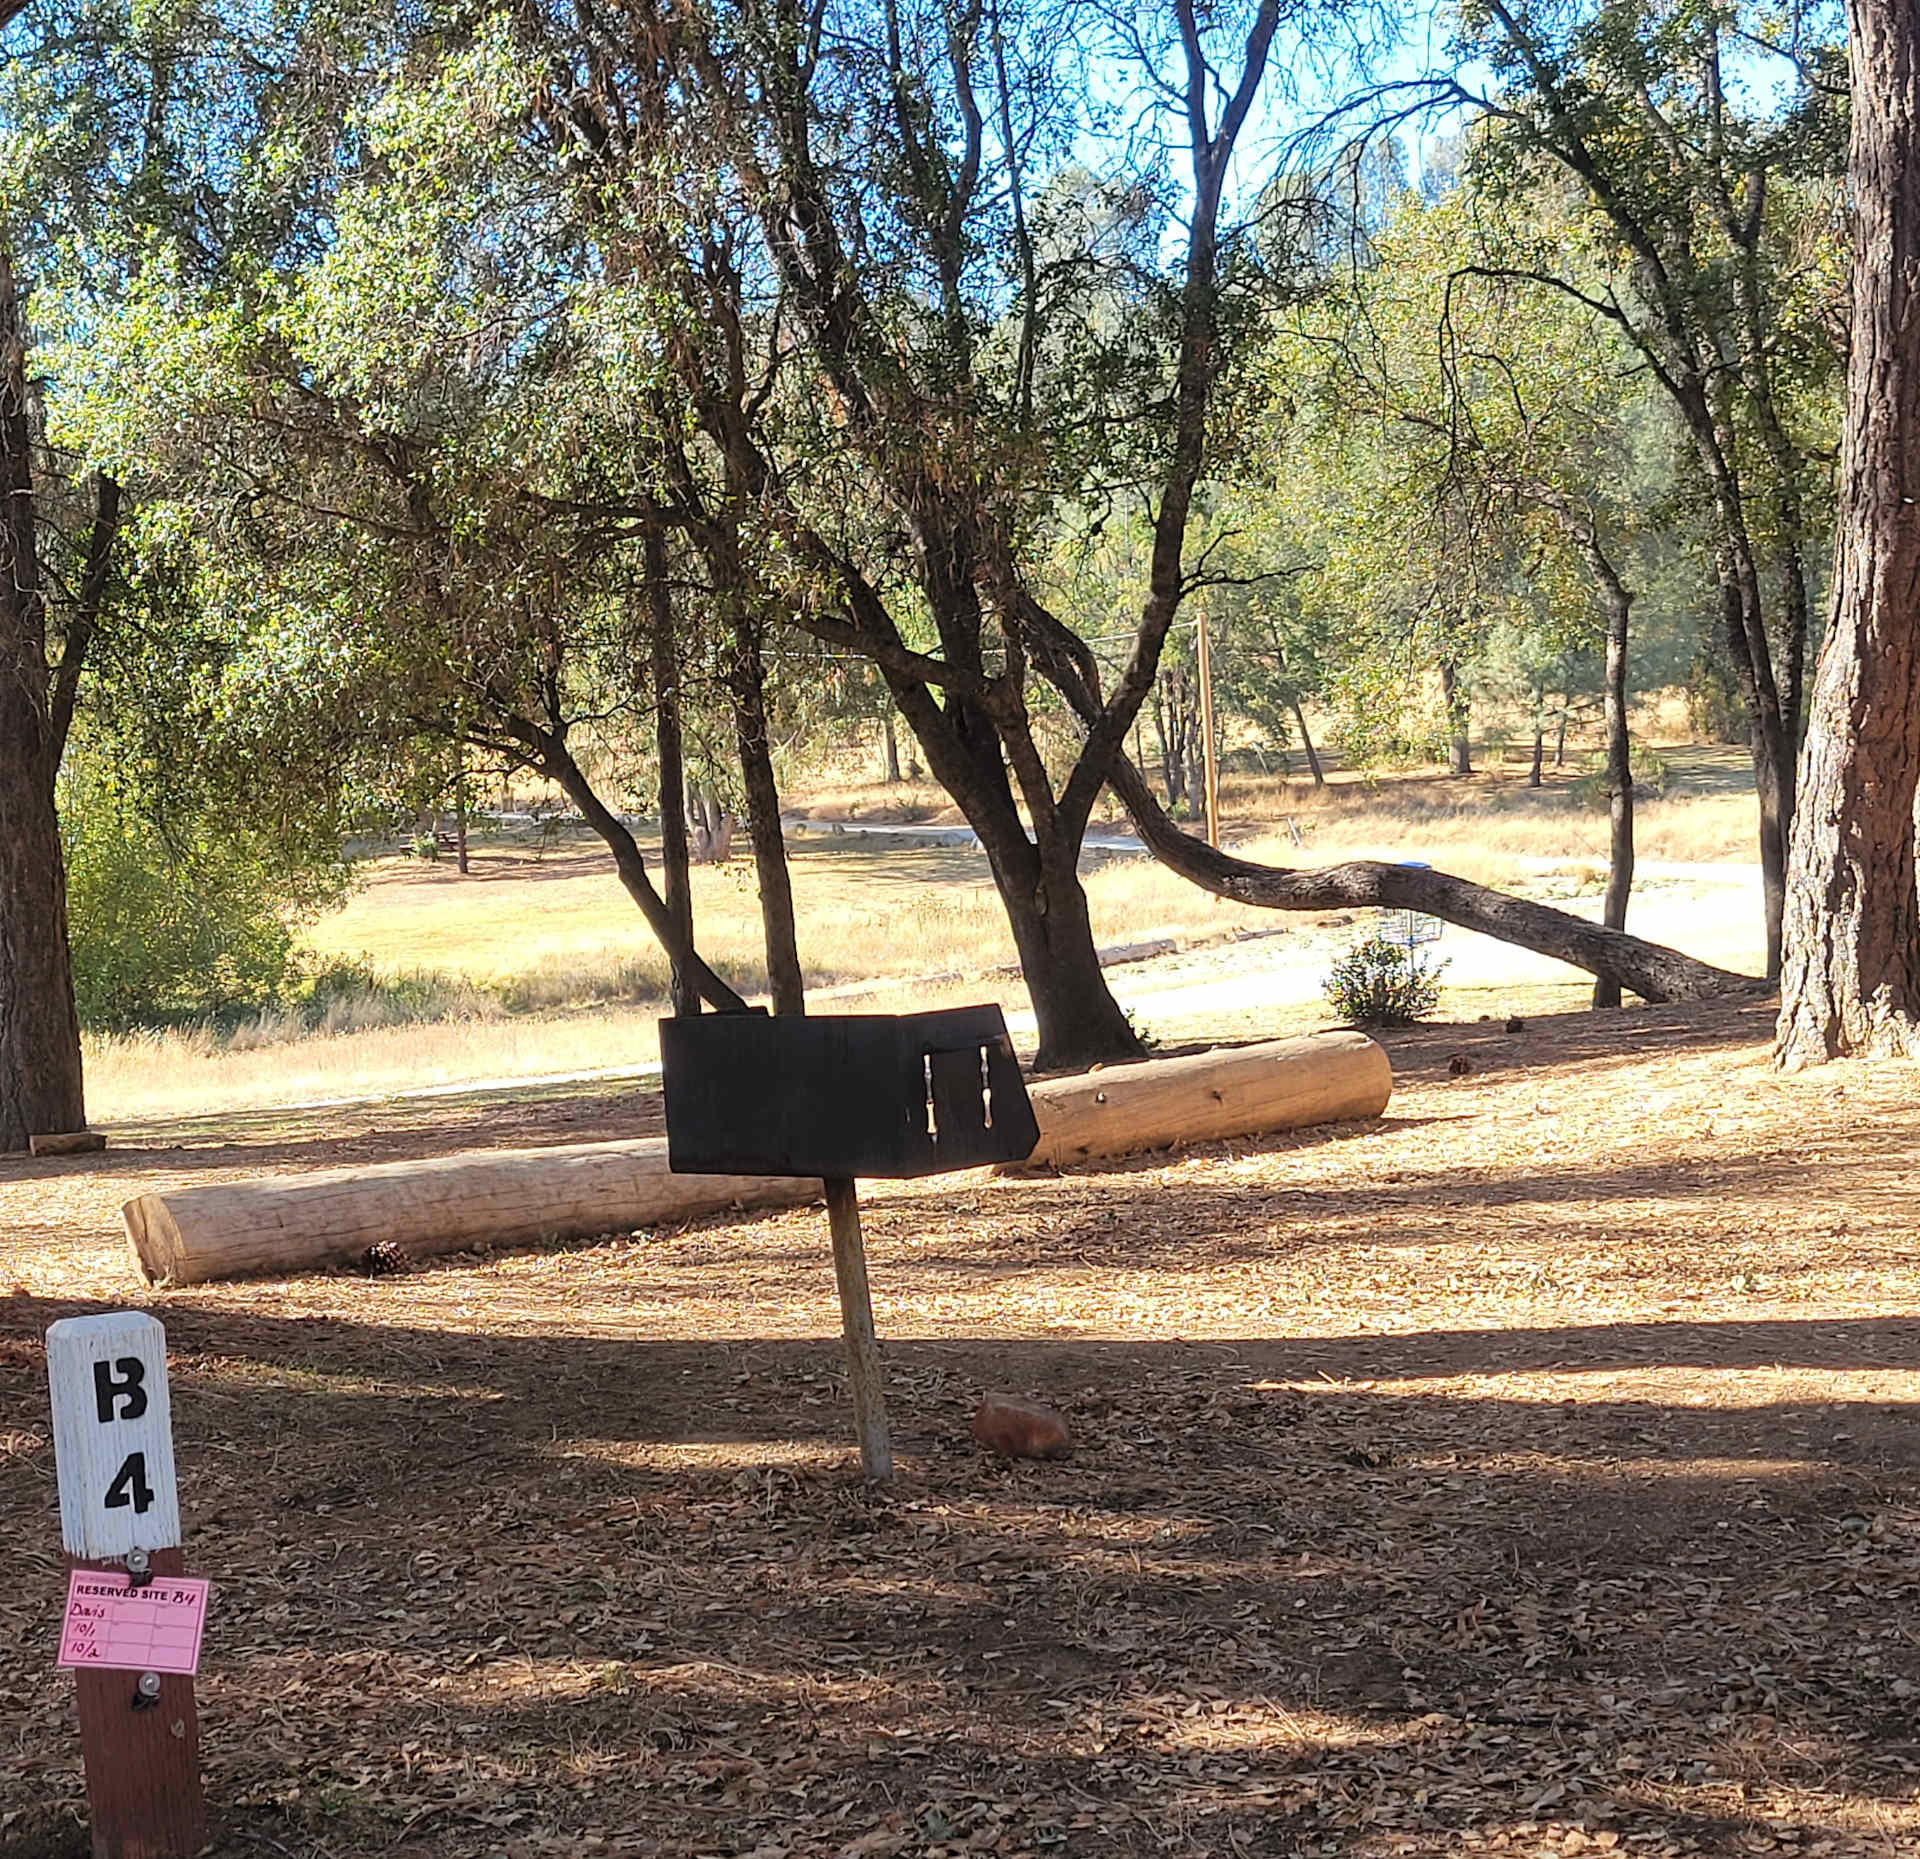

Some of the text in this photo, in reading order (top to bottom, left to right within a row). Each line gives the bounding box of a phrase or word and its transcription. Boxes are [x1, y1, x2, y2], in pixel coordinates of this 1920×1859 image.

[93, 1357, 148, 1423] B
[104, 1452, 154, 1514] 4
[76, 1585, 196, 1605] RESERVED SITE B4
[71, 1640, 100, 1658] 10/2
